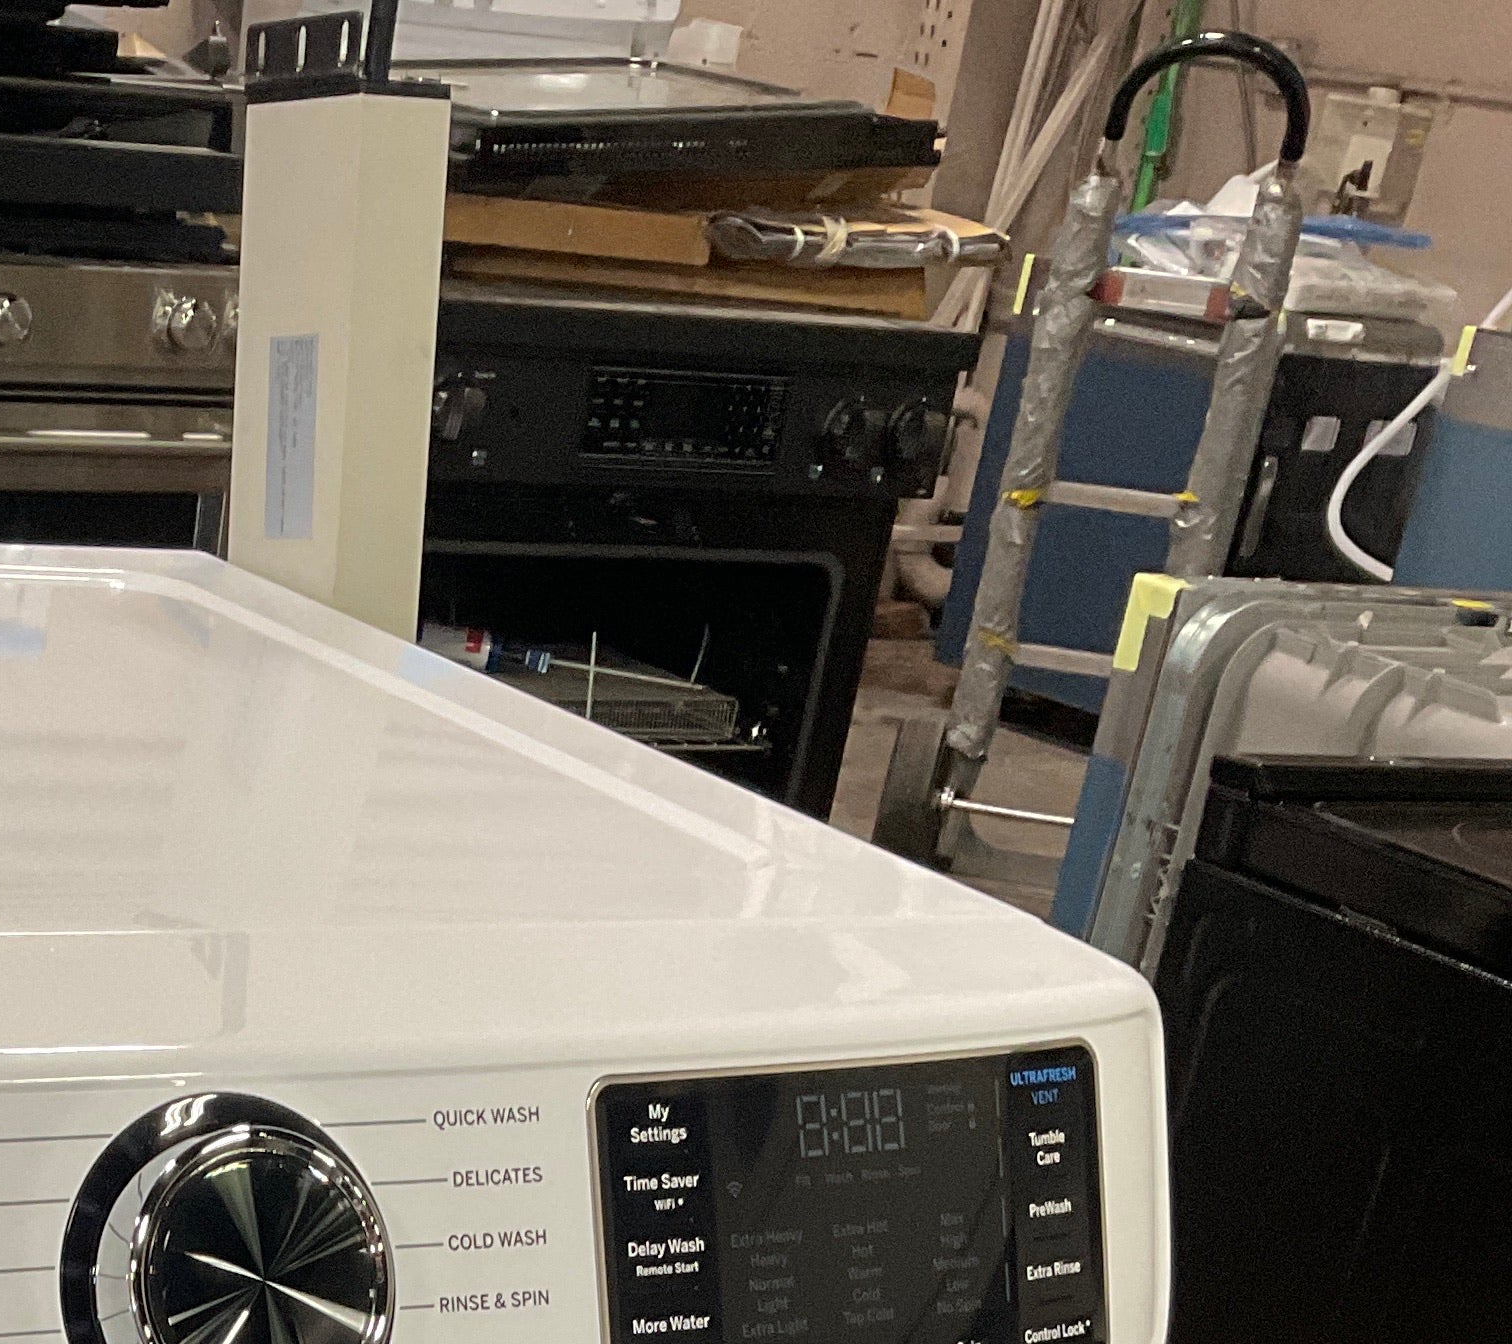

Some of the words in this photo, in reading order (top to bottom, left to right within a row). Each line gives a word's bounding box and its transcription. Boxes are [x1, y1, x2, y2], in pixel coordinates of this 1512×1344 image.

[1010, 1066, 1077, 1087] ULTRAFRESH
[1031, 1088, 1060, 1105] VENT
[433, 1108, 487, 1130] QUICK
[491, 1106, 540, 1125] WASH
[648, 1103, 670, 1122] My
[630, 1126, 688, 1144] Settings
[1029, 1129, 1065, 1148] Tumble
[1037, 1149, 1061, 1166] Care
[452, 1166, 543, 1187] DELICATES
[623, 1175, 658, 1191] Time
[661, 1172, 699, 1190] Saver
[654, 1198, 676, 1211] WiFi
[1029, 1198, 1072, 1219] PreWash
[448, 1232, 494, 1251] COLD
[498, 1229, 547, 1248] WASH
[628, 1240, 666, 1259] Delay
[668, 1237, 705, 1255] Wash
[636, 1263, 673, 1277] Remote
[675, 1260, 699, 1274] Start
[1026, 1263, 1053, 1281] Extra
[1054, 1260, 1081, 1278] Rinse
[439, 1293, 490, 1313] RINSE
[494, 1292, 506, 1309] &
[511, 1290, 550, 1308] SPIN
[632, 1317, 667, 1334] More
[670, 1314, 710, 1332] Water
[1024, 1323, 1061, 1344] Control
